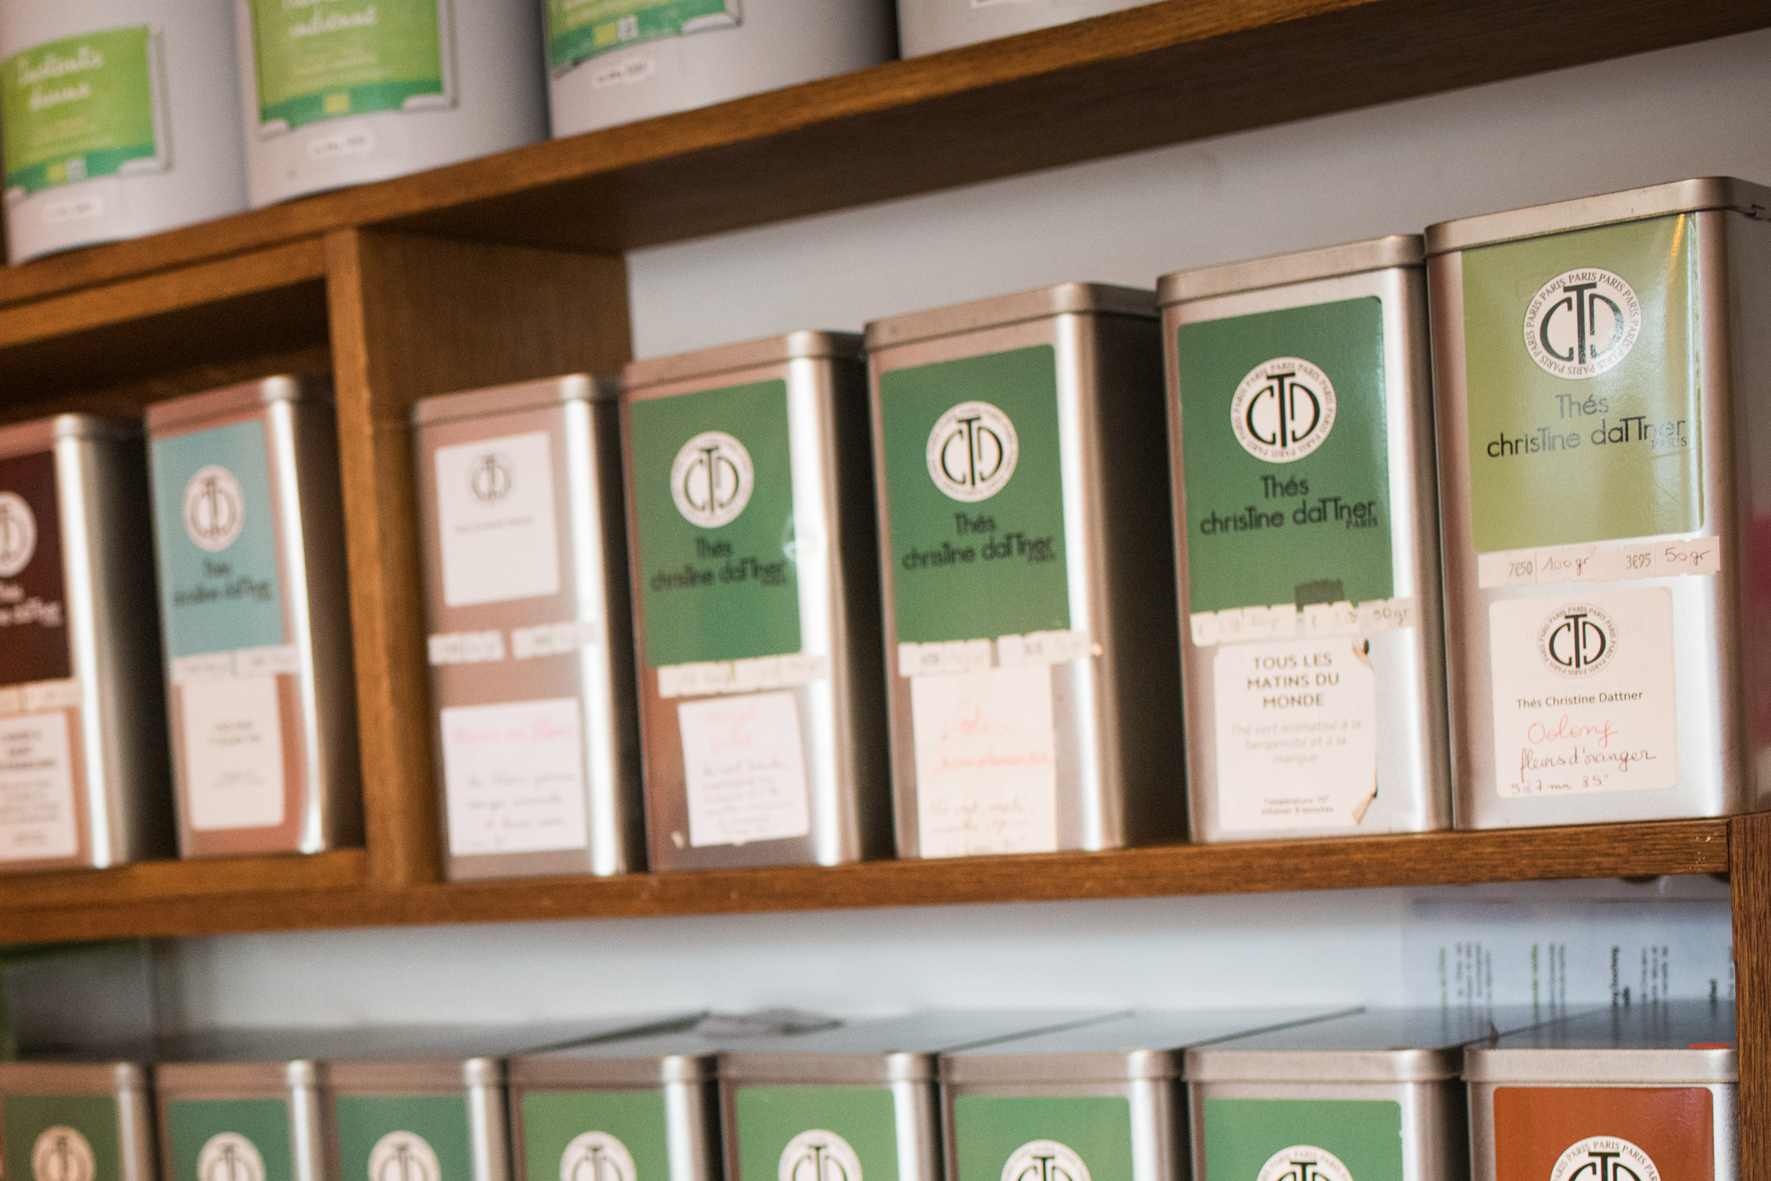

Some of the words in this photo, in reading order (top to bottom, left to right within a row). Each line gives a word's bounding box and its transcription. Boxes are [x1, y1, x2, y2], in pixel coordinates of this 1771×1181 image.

[1555, 393, 1610, 419] Thés
[1260, 474, 1309, 499] Thés
[1253, 655, 1297, 671] TOUS
[1303, 653, 1332, 669] LES
[1247, 674, 1309, 691] MATINS
[1316, 673, 1340, 687] DU
[1263, 694, 1324, 709] MONDE
[1516, 698, 1542, 709] Thés
[1545, 694, 1595, 707] Christine
[1599, 691, 1643, 703] Dattner
